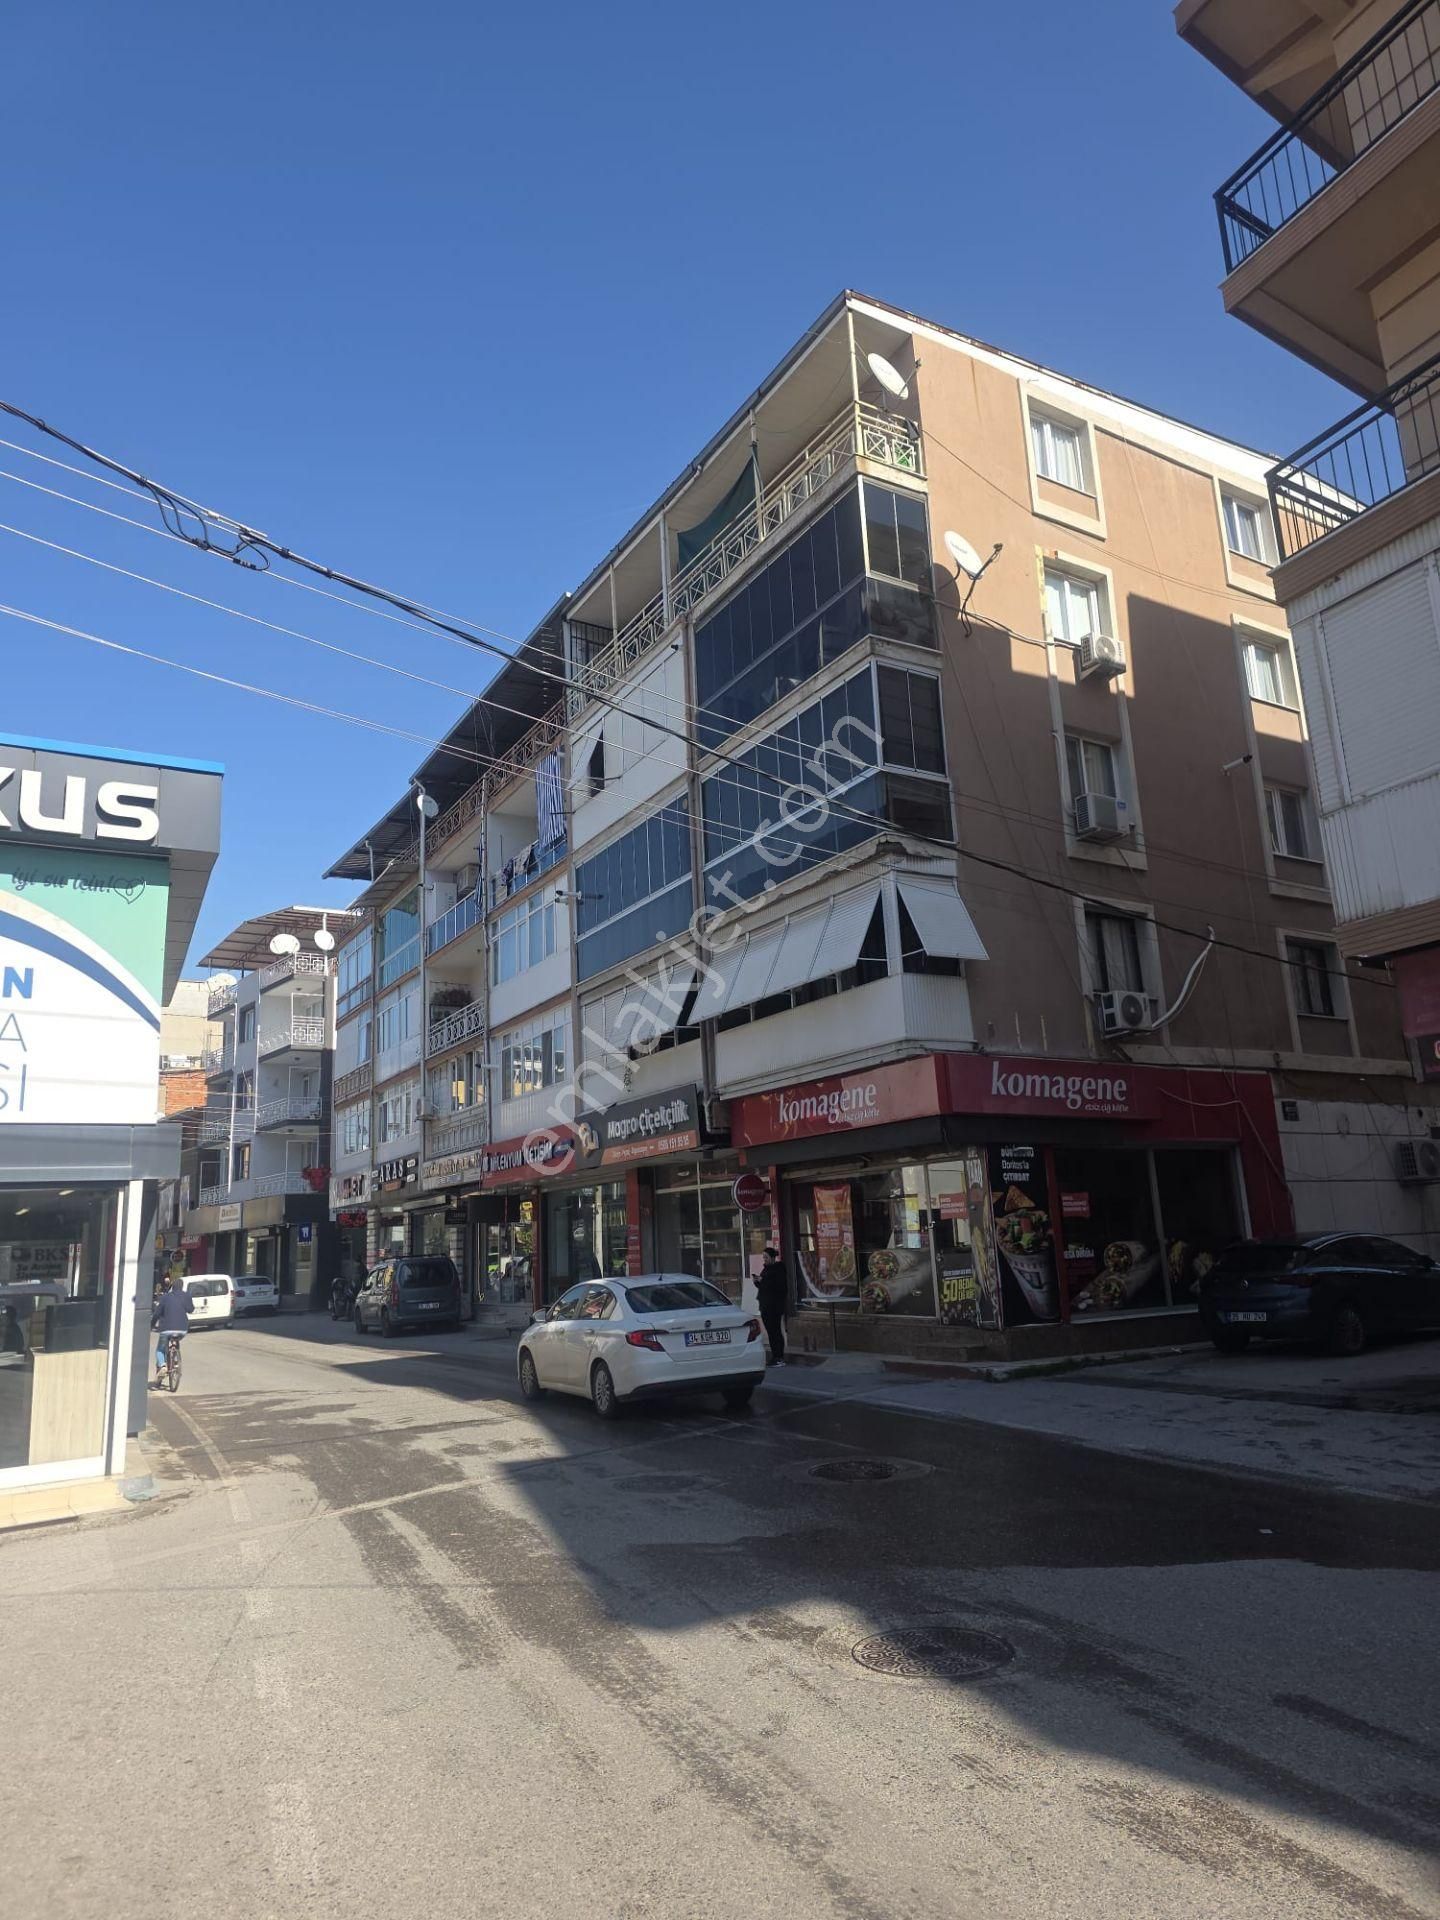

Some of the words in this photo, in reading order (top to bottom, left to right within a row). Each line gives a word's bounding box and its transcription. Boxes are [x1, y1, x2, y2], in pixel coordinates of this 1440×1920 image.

[779, 1083, 877, 1124] komagene
[991, 1060, 1127, 1110] komagene
[607, 1117, 637, 1139] Magro
[639, 1099, 690, 1136] Çiçekçilik
[379, 1159, 404, 1182] ARAS
[943, 1280, 958, 1303] 50
